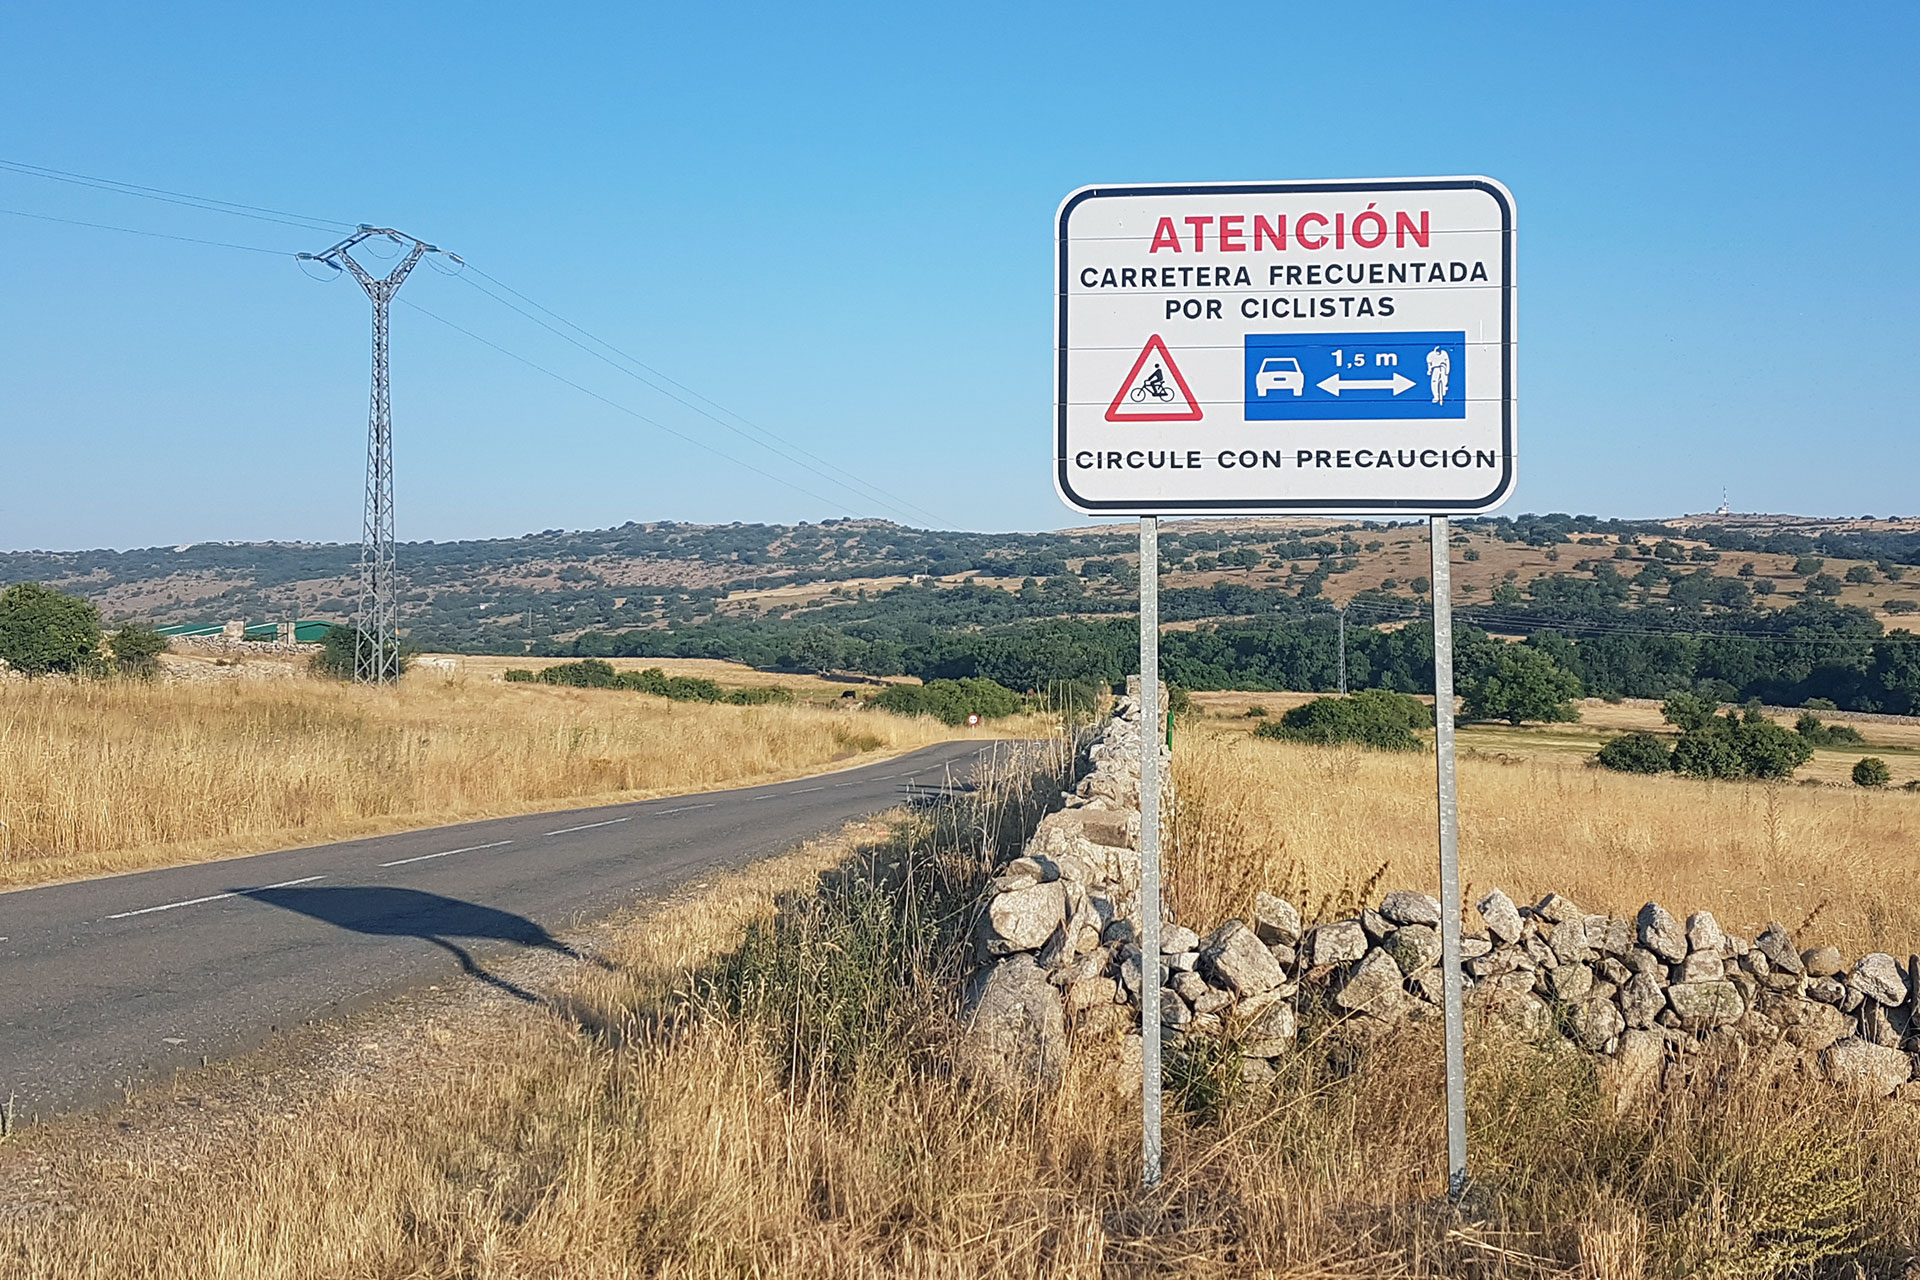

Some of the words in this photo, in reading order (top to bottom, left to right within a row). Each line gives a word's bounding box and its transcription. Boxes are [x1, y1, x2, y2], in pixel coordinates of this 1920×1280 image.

[1149, 202, 1430, 254] ATENCIÓN
[1080, 266, 1252, 288] CARRETERA
[1269, 261, 1488, 286] FRECUENTADA
[1165, 299, 1223, 320] POR
[1241, 296, 1395, 319] CICLISTAS
[1331, 349, 1365, 368] 1,5
[1376, 352, 1398, 367] m
[1075, 450, 1202, 470] CIRCULE
[1217, 449, 1281, 469] CON
[1296, 446, 1496, 469] PRECAUCIÓN
